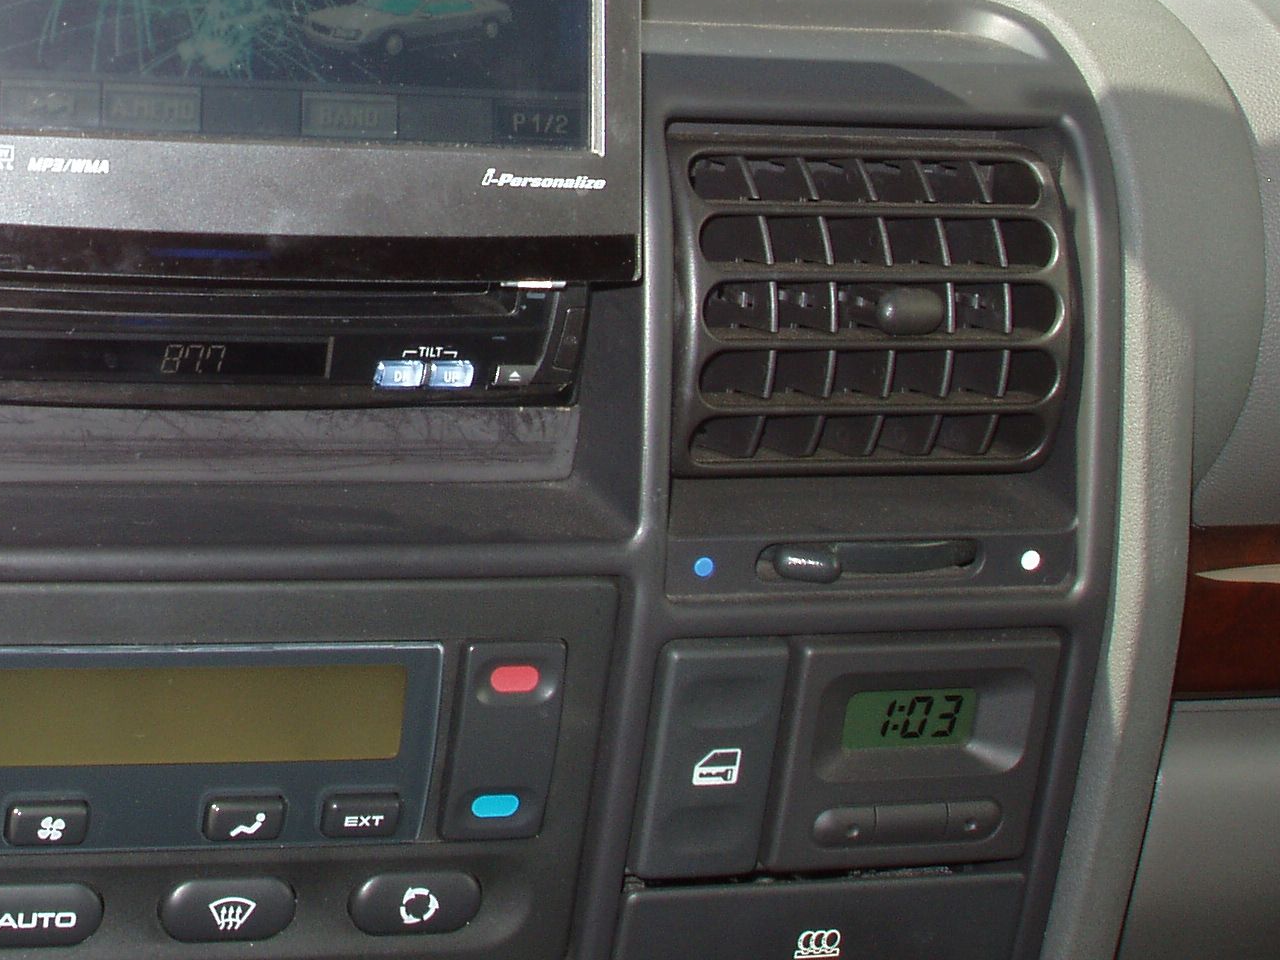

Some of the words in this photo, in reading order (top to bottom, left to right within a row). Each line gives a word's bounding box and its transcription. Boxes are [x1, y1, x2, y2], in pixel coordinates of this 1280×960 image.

[318, 104, 379, 128] BAND
[419, 346, 444, 359] TILT
[393, 370, 411, 383] DN
[442, 370, 460, 383] UP
[880, 695, 964, 738] 1:03
[344, 814, 385, 828] EXT
